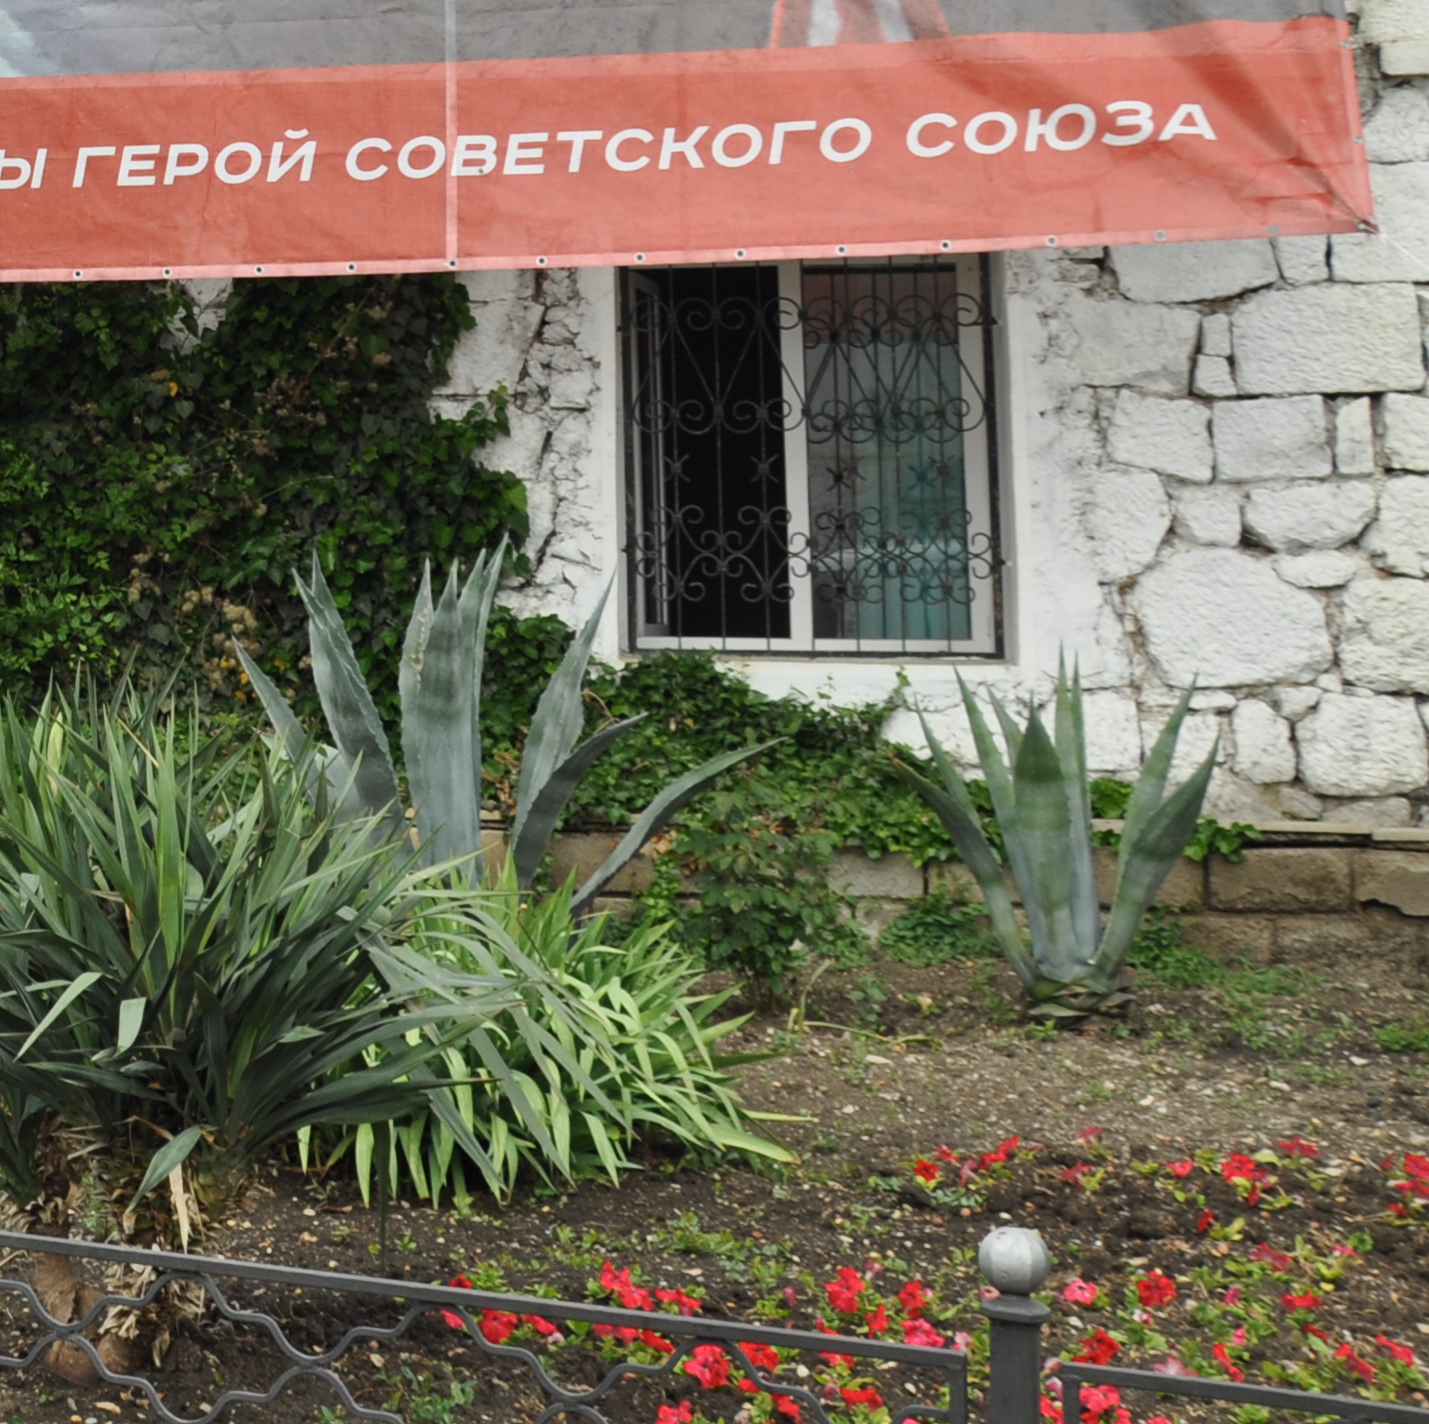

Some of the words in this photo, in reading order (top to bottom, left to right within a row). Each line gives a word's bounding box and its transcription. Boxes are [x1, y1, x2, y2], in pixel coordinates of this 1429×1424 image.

[72, 128, 317, 187] ГЕРОЙ
[345, 116, 872, 181] СОВЕТСКОГО
[905, 100, 1218, 159] СОЮЗА
